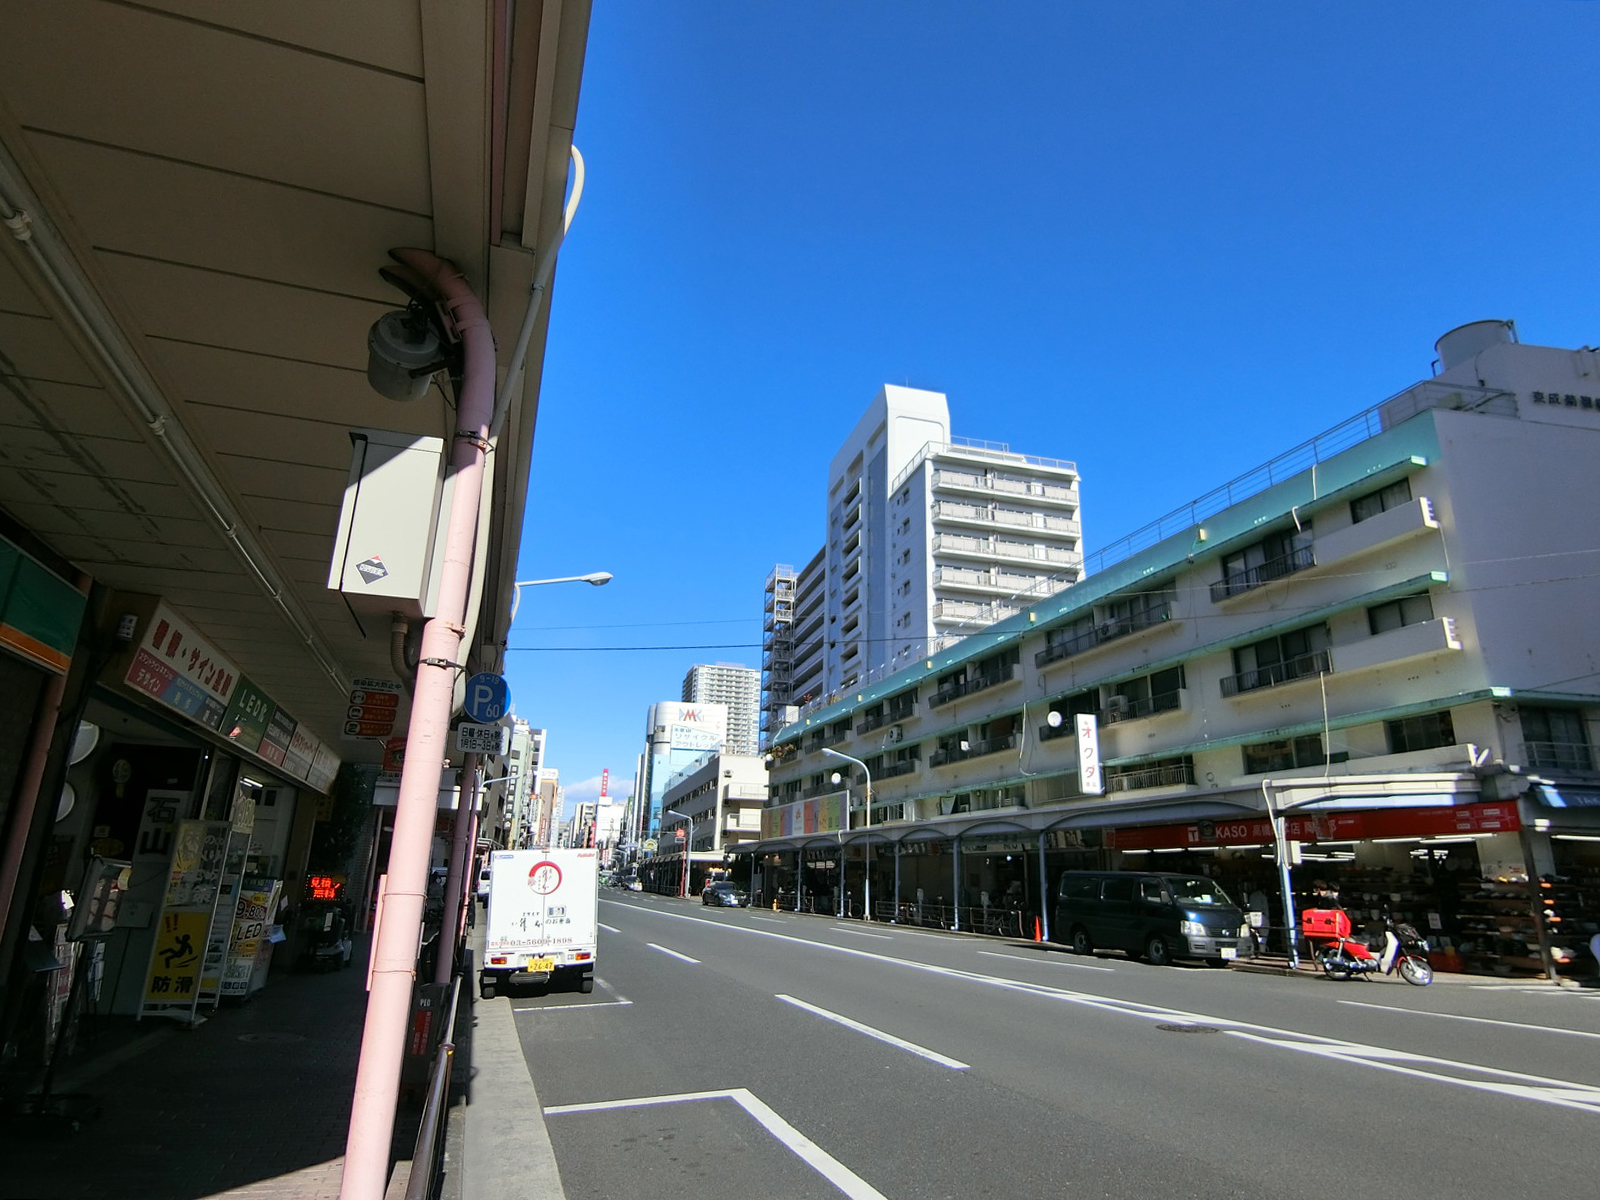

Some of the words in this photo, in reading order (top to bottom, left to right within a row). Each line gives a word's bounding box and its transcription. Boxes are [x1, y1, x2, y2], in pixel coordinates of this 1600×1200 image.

[479, 675, 500, 685] 9-19
[472, 685, 493, 716] P
[486, 703, 500, 718] 60
[675, 733, 716, 741] リサイクル
[1082, 726, 1095, 778] オクダ
[139, 796, 181, 856] 石山
[1215, 825, 1248, 839] KASO
[236, 922, 263, 941] LED
[151, 976, 194, 994] 防滑
